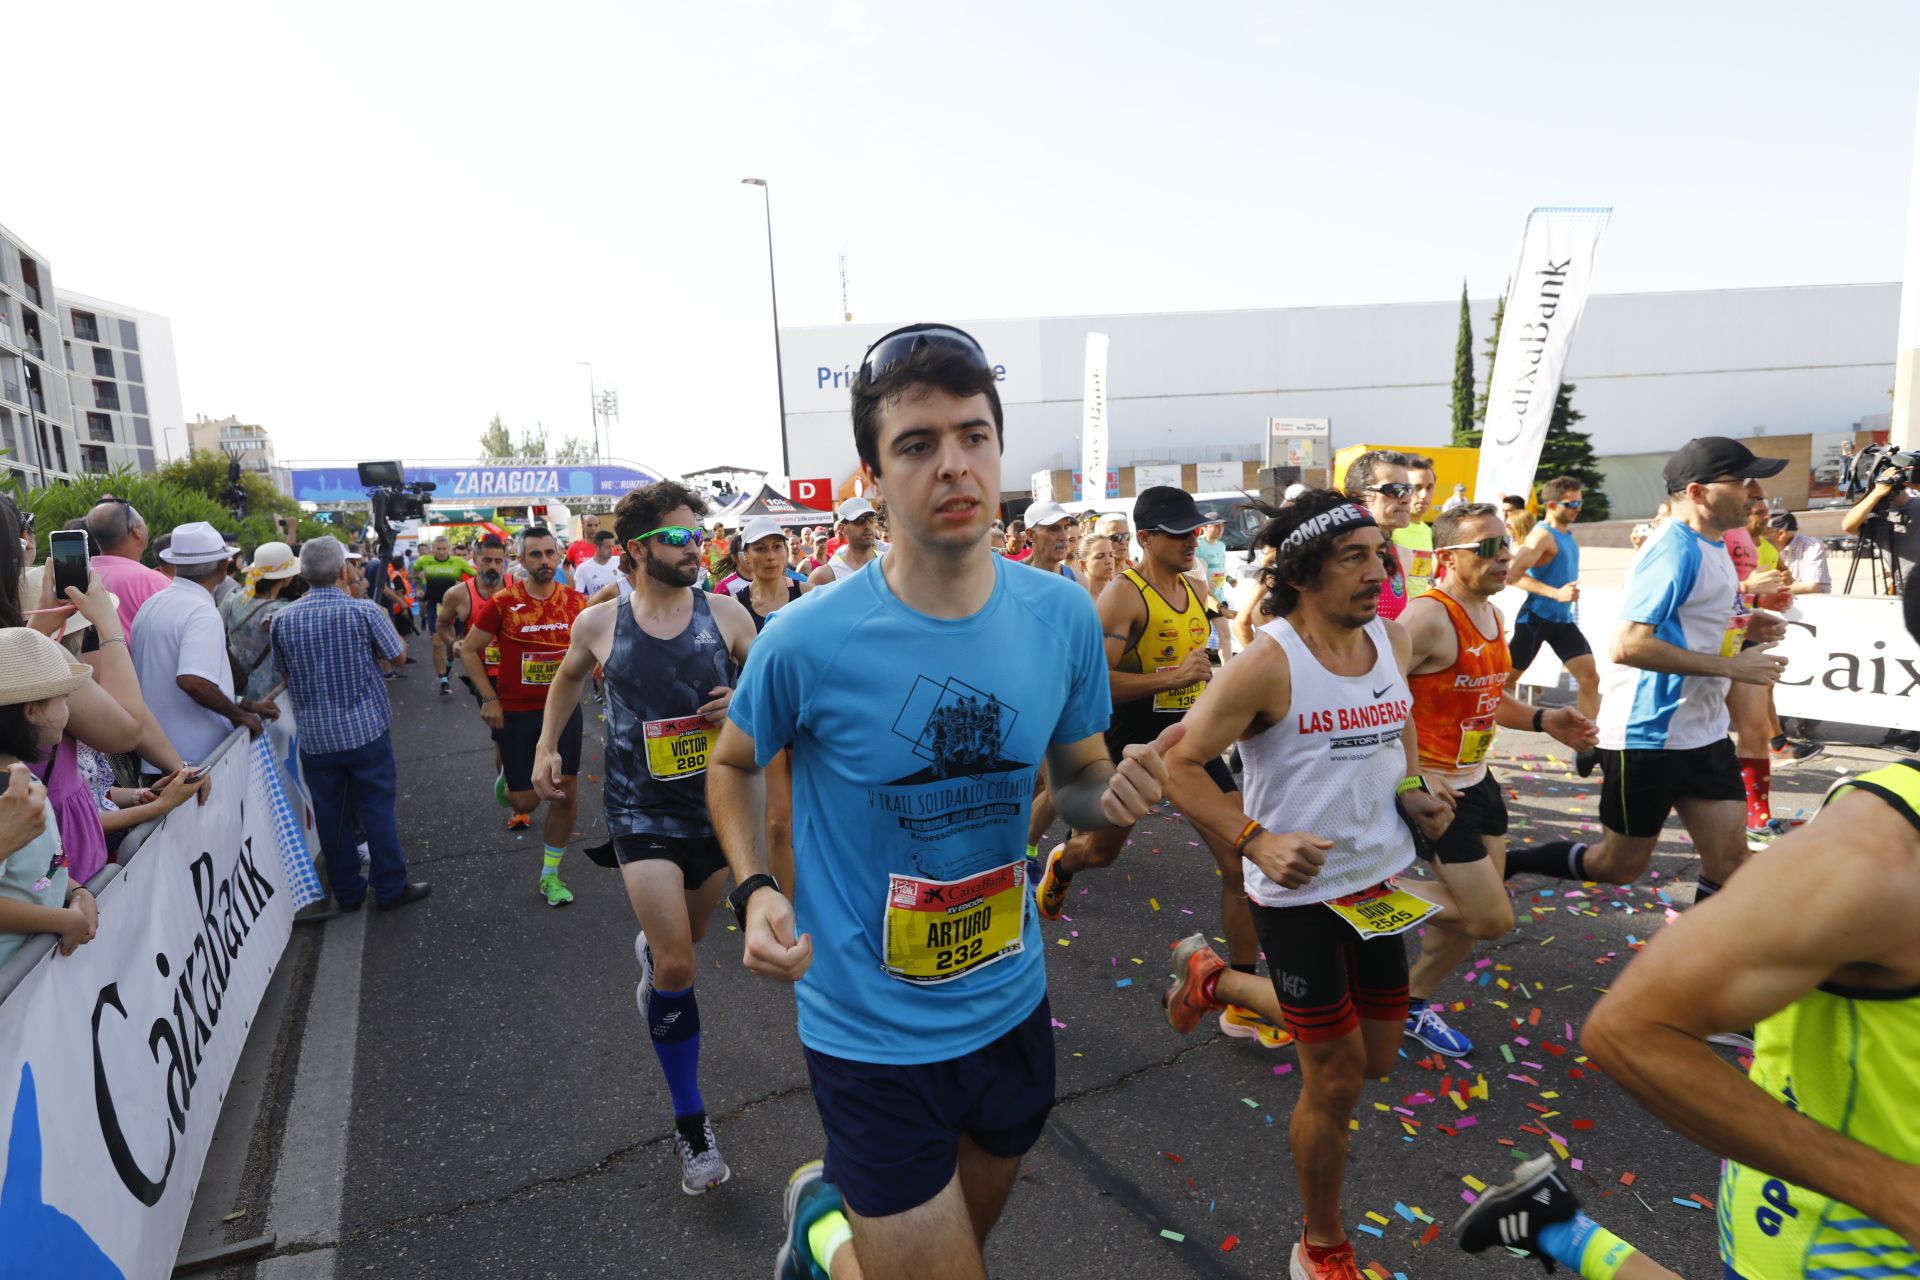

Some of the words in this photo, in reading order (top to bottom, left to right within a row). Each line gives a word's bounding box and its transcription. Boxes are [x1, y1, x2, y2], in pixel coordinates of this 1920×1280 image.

[1496, 258, 1571, 447] CaixaBank
[454, 471, 560, 494] ZARAGOZA
[601, 480, 614, 490] WE
[799, 482, 816, 499] D
[1280, 503, 1366, 553] COMPRE
[521, 623, 569, 633] ESPAÑA
[528, 664, 544, 673] JOSE
[1298, 710, 1334, 735] LAS
[1337, 700, 1408, 731] BANDERAS
[1330, 735, 1378, 748] FACTORY
[676, 755, 705, 771] 280
[878, 792, 914, 815] TRAIL
[918, 782, 984, 816] SOLIDARIO
[948, 872, 1007, 900] CaixaBank
[947, 906, 957, 914] XV
[1357, 901, 1395, 920] DAVID
[1370, 910, 1413, 930] 2545
[926, 906, 992, 948] ARTURO
[936, 938, 983, 971] 232
[91, 836, 275, 1208] CaixaBank
